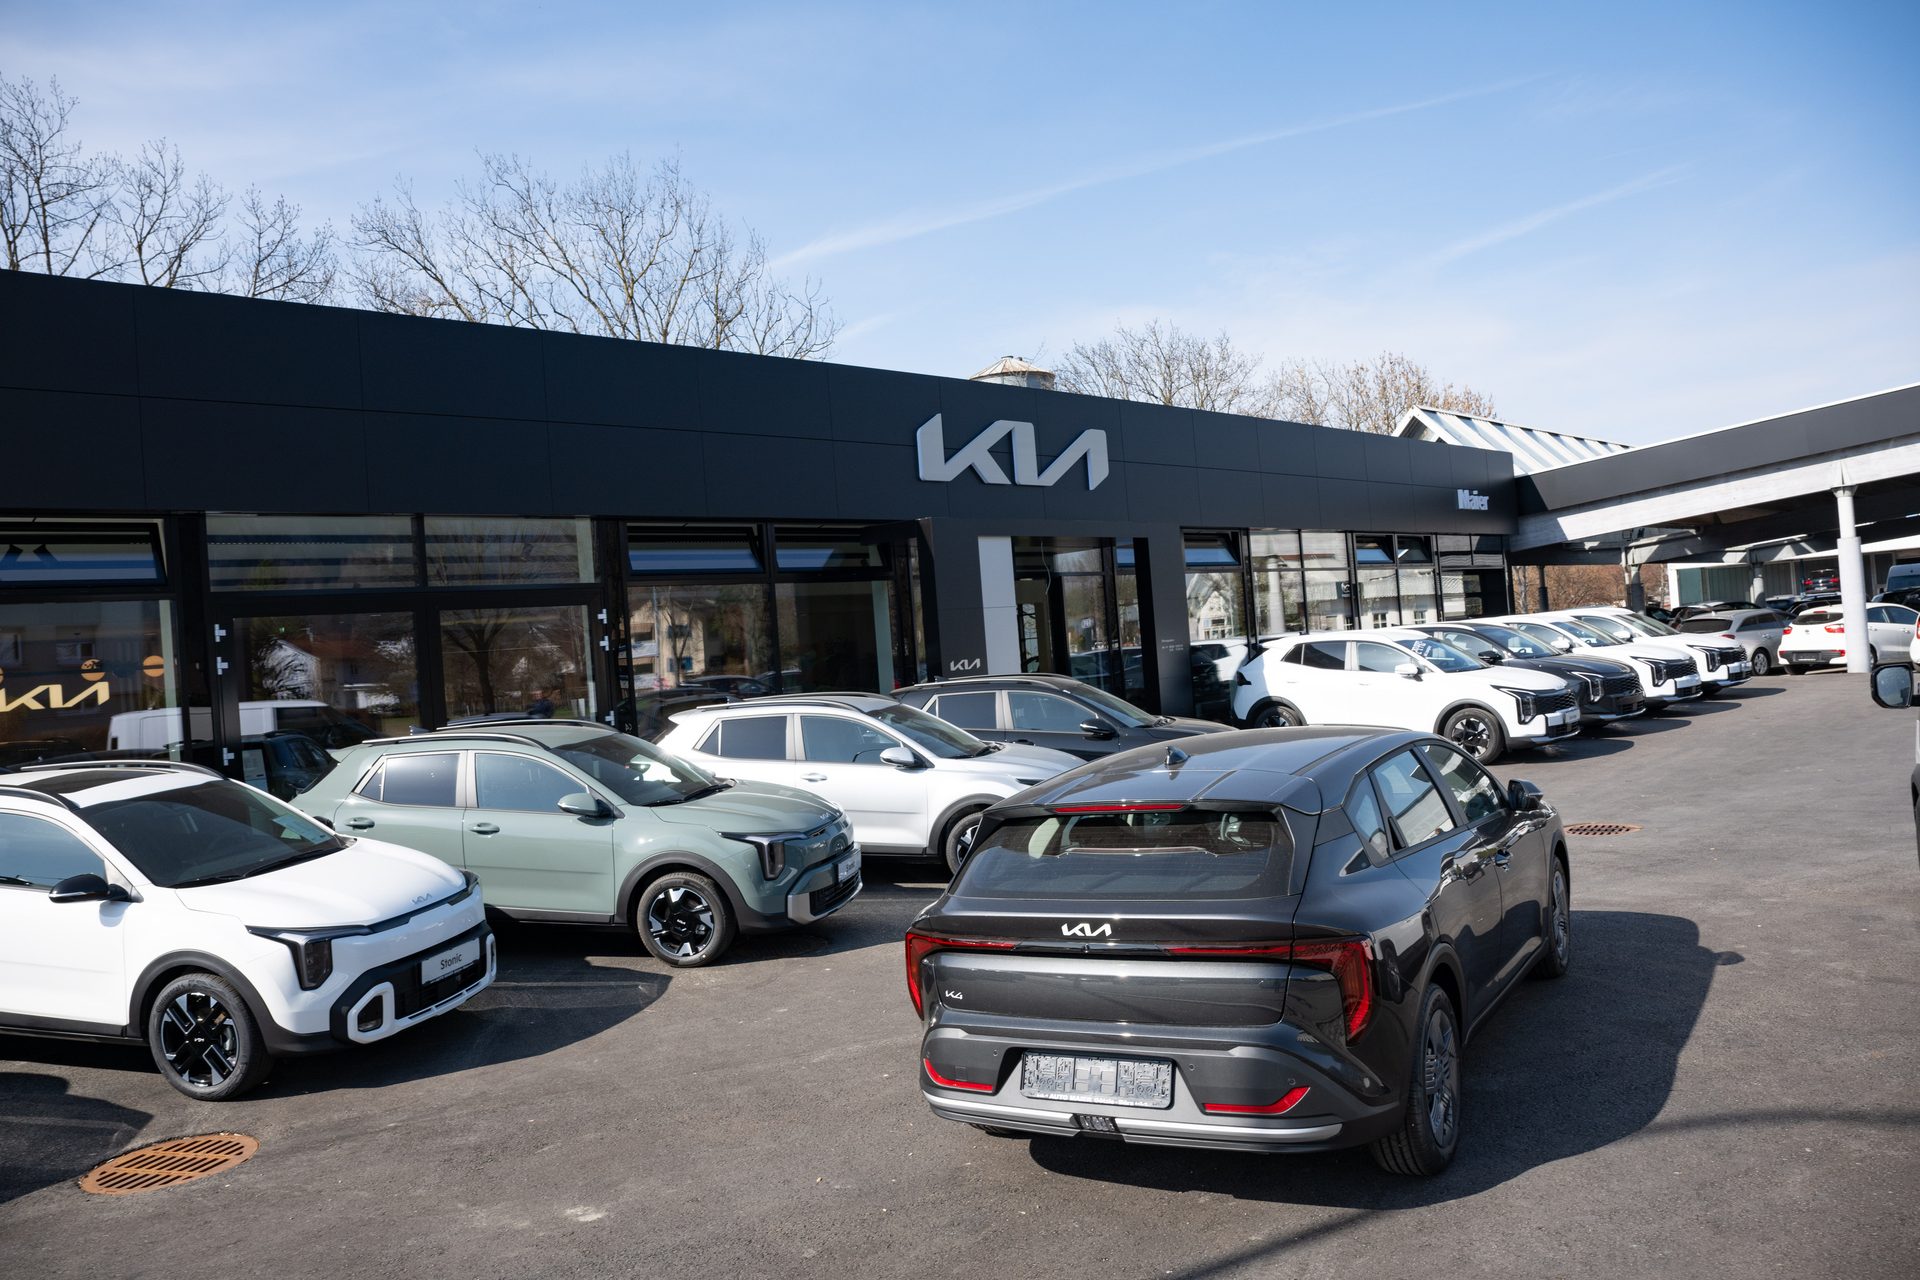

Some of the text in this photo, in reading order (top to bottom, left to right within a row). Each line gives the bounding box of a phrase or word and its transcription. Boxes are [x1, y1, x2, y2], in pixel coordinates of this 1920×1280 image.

[917, 413, 1109, 490] KIA
[1457, 489, 1489, 510] Maier
[950, 658, 980, 671] KIA
[0, 682, 110, 712] KIA
[411, 893, 433, 904] KIA
[1061, 923, 1112, 936] KIA
[440, 953, 462, 970] Stonic
[945, 990, 963, 1000] K4
